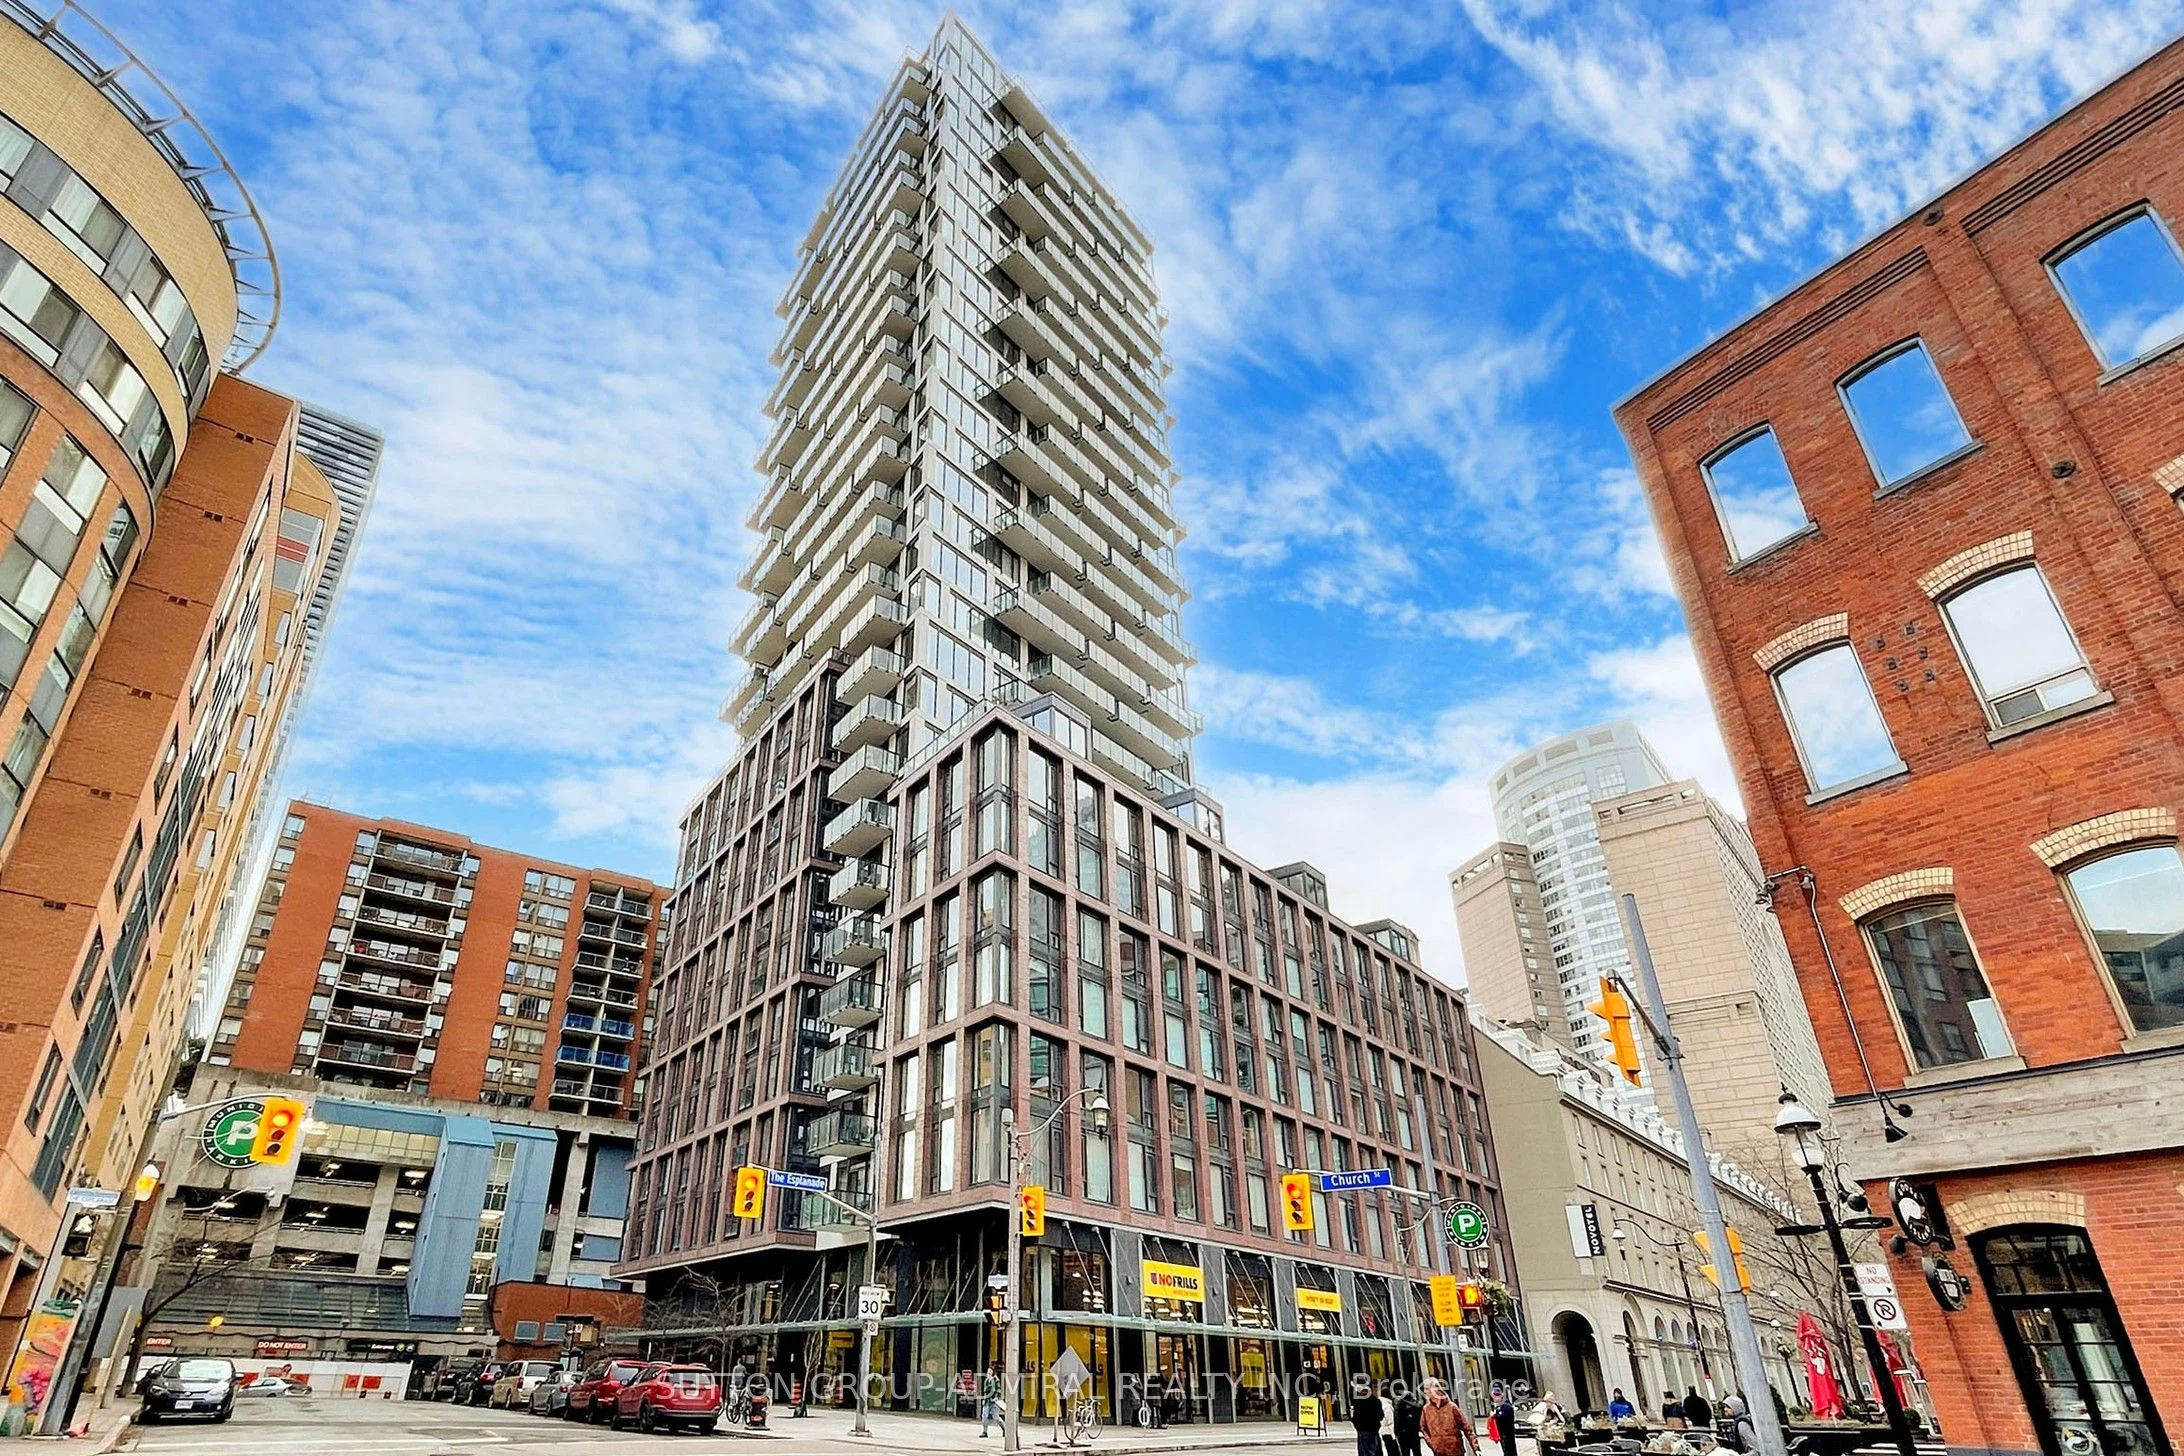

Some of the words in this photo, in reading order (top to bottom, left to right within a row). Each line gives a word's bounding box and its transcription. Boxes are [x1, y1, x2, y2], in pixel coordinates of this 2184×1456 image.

[771, 1171, 785, 1184] The
[787, 1173, 825, 1189] Esplanade
[1330, 1172, 1371, 1187] Church
[1585, 1206, 1601, 1255] NOVOTEL
[1865, 1266, 1877, 1275] NO
[861, 1300, 879, 1314] 30
[257, 1341, 269, 1349] DO
[269, 1341, 283, 1349] NOT
[283, 1342, 307, 1350] ENTER
